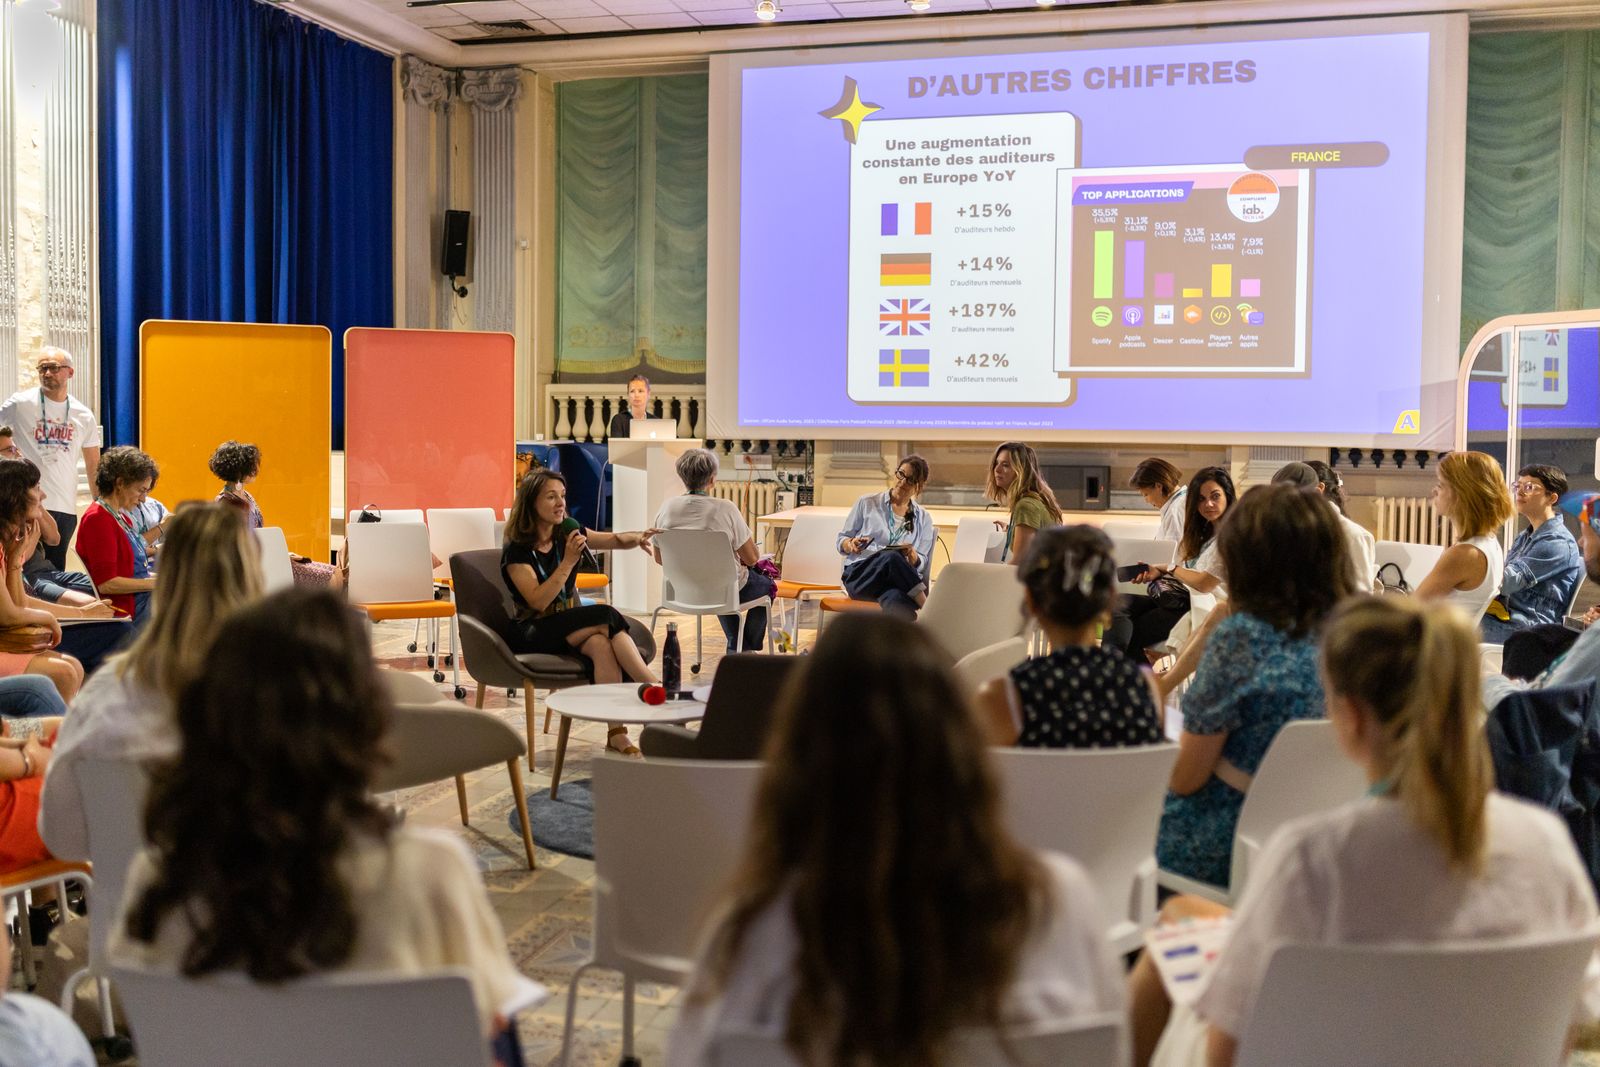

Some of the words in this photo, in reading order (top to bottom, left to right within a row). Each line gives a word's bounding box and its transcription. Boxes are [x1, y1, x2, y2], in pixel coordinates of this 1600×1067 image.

[1083, 59, 1257, 90] CHIFFRES
[885, 140, 916, 151] Une
[921, 135, 1032, 152] augmentation
[862, 155, 941, 168] constante
[946, 154, 974, 165] des
[979, 152, 1056, 165] auditeurs
[1291, 151, 1341, 163] FRANCE
[899, 174, 918, 185] en
[923, 173, 978, 186] Europe
[983, 170, 1016, 182] YoY
[1082, 191, 1103, 200] TOP
[1105, 188, 1185, 199] APPLICATIONS
[956, 203, 1012, 218] +15%
[1242, 237, 1263, 246] 7,9%
[957, 256, 1013, 271] +14%
[949, 303, 1017, 317] +187%
[954, 353, 1010, 368] +42%
[1400, 414, 1416, 429] A
